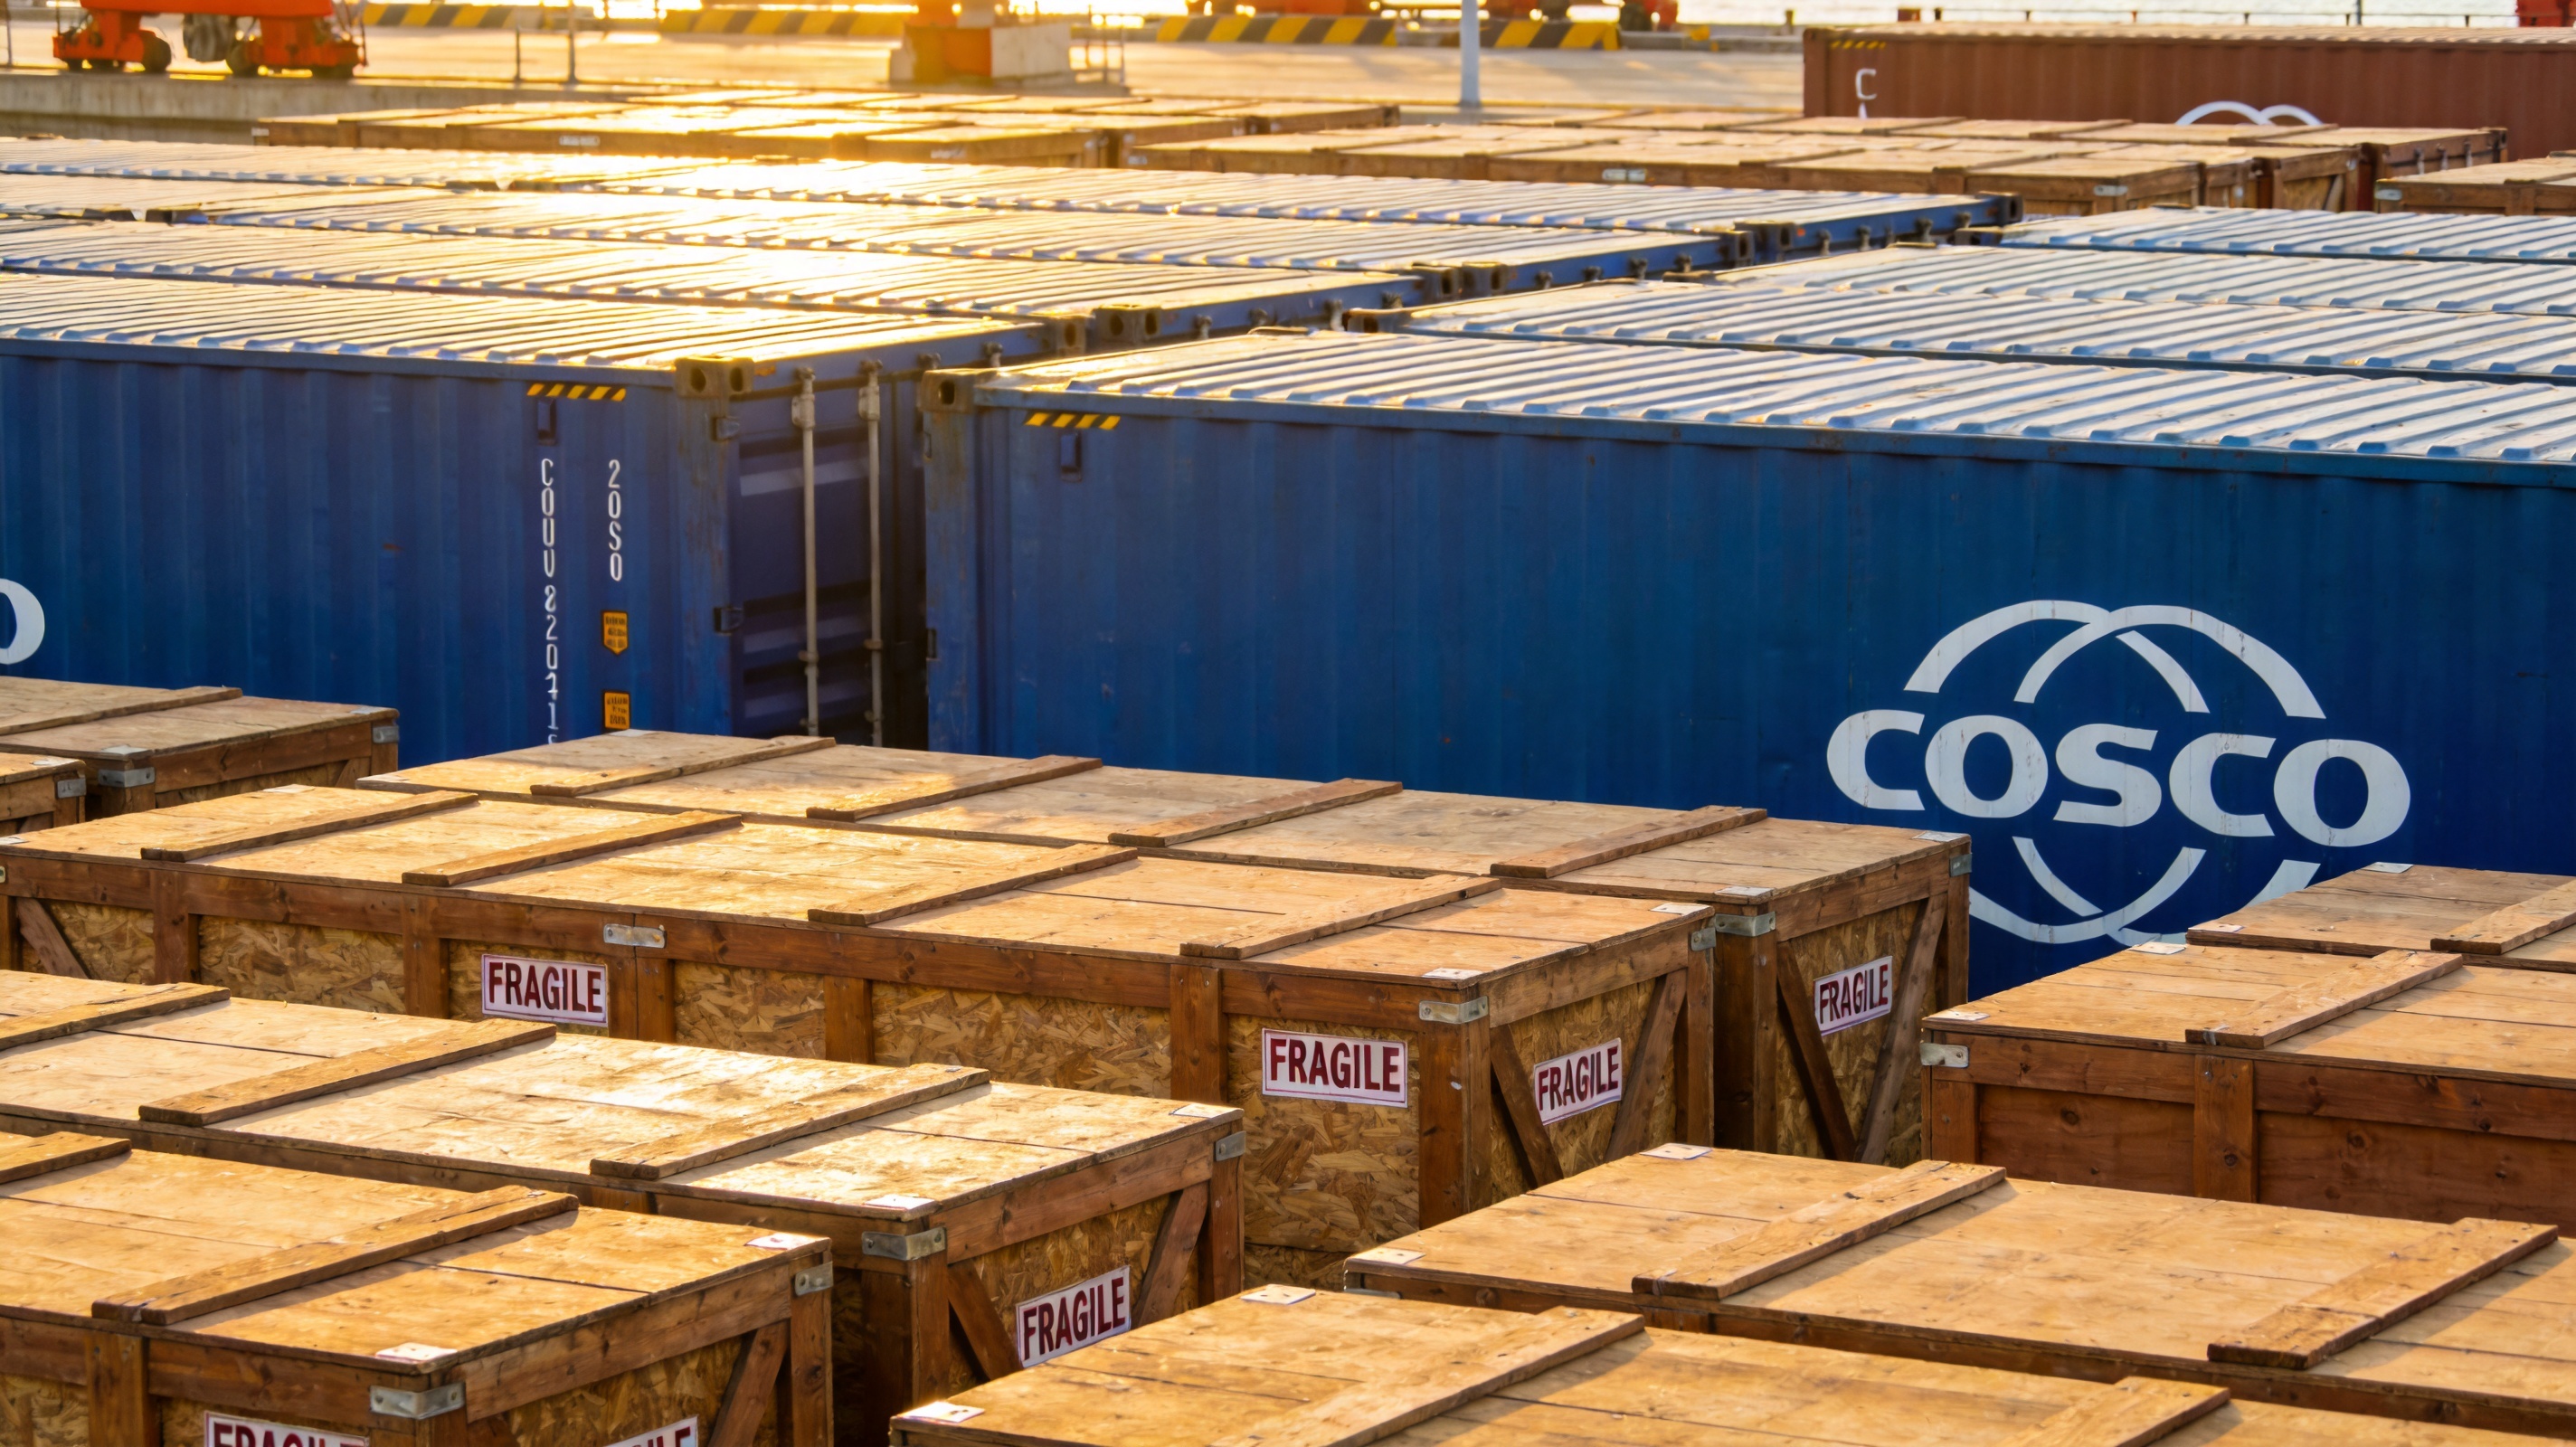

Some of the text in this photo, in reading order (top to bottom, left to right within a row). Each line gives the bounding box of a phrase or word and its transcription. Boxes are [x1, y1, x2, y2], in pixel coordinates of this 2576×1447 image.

[1826, 709, 2411, 847] COSCO
[488, 961, 602, 1013] FRAGILE
[1819, 963, 1889, 1025] FRAGILE
[1270, 1037, 1401, 1092] FRAGILE
[1538, 1045, 1619, 1111] FRAGILE
[1022, 1276, 1126, 1361] FRAGILE
